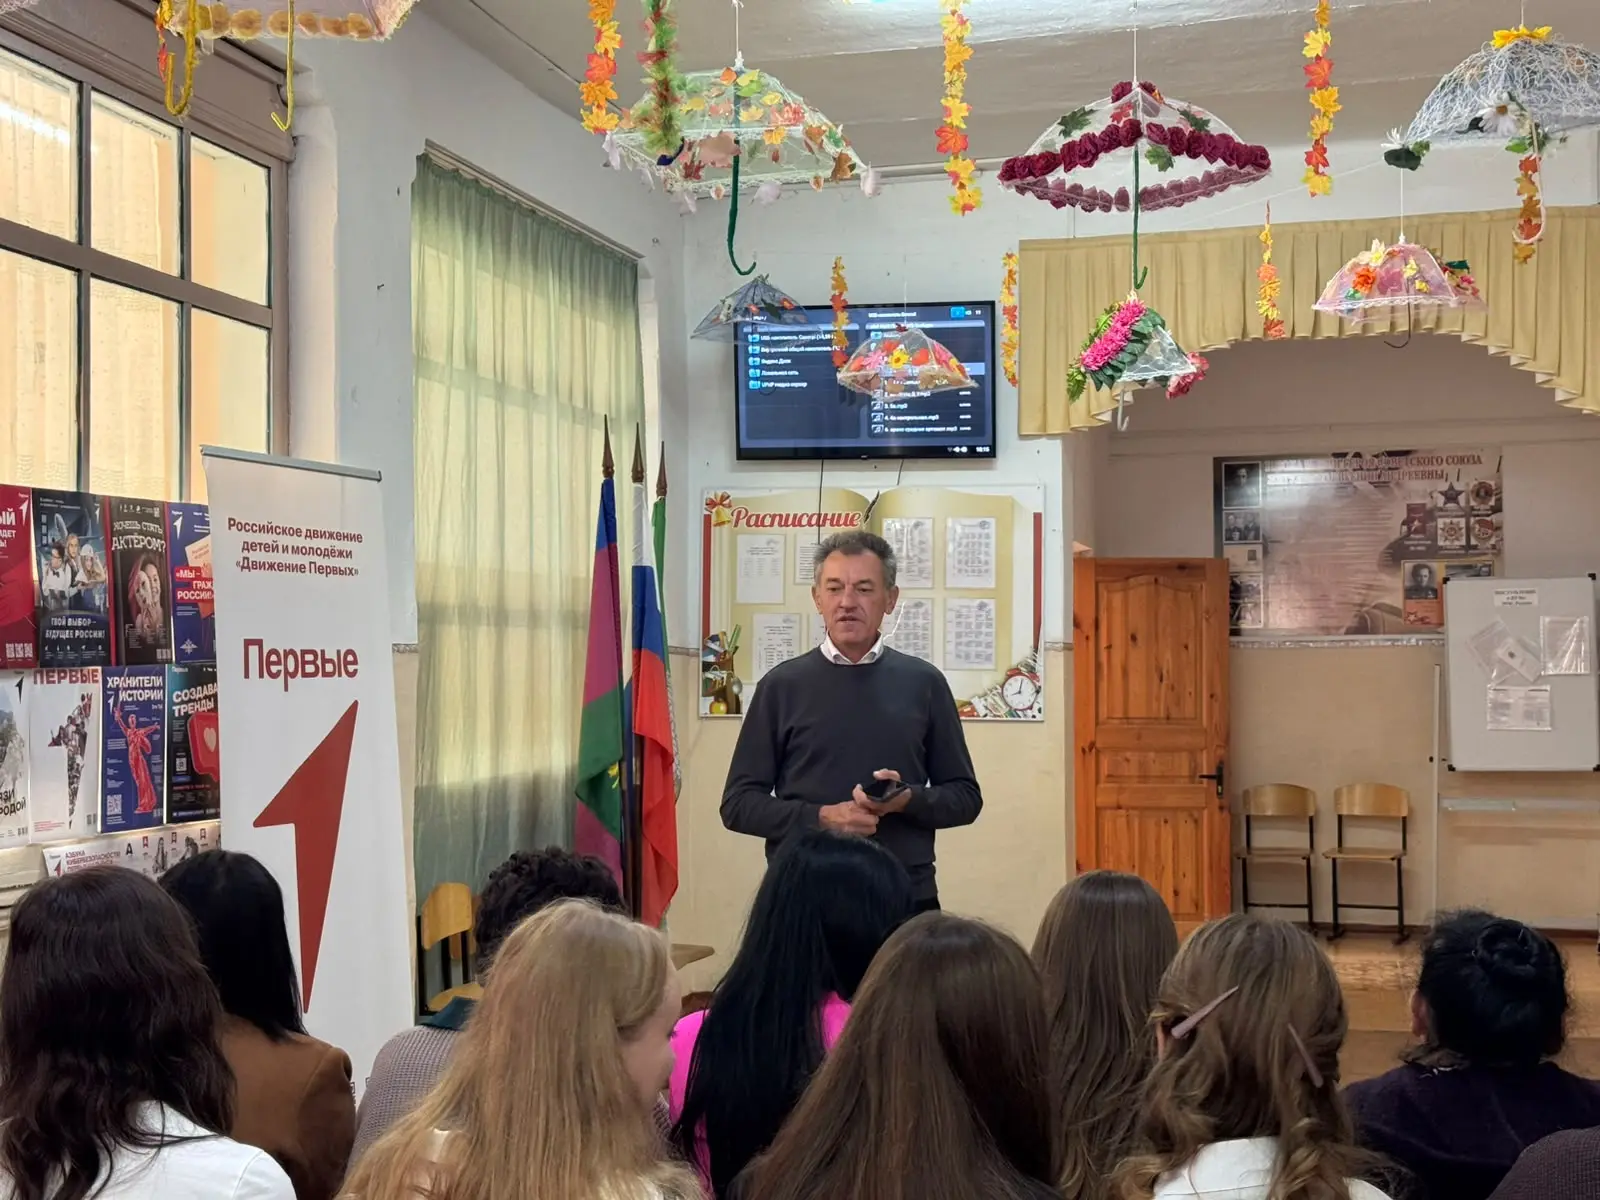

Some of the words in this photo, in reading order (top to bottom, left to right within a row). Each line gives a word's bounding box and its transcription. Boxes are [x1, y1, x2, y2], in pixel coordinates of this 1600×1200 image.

[1445, 453, 1483, 466] СОЮЗА
[731, 506, 862, 529] Расписание
[228, 517, 302, 537] Российское
[304, 527, 363, 543] движение
[242, 541, 279, 554] детей
[282, 544, 289, 554] и
[291, 544, 353, 560] молодёжи
[235, 556, 307, 574] «Движение
[308, 561, 359, 577] Первых»
[193, 580, 214, 590] ГРАЖ
[243, 638, 359, 693] Первые
[33, 668, 99, 684] ПЕРВЫЕ
[106, 676, 163, 689] ХРАНИТЕЛИ
[119, 689, 163, 702] ИСТОРИИ
[172, 699, 215, 717] ТРЕНДЫ
